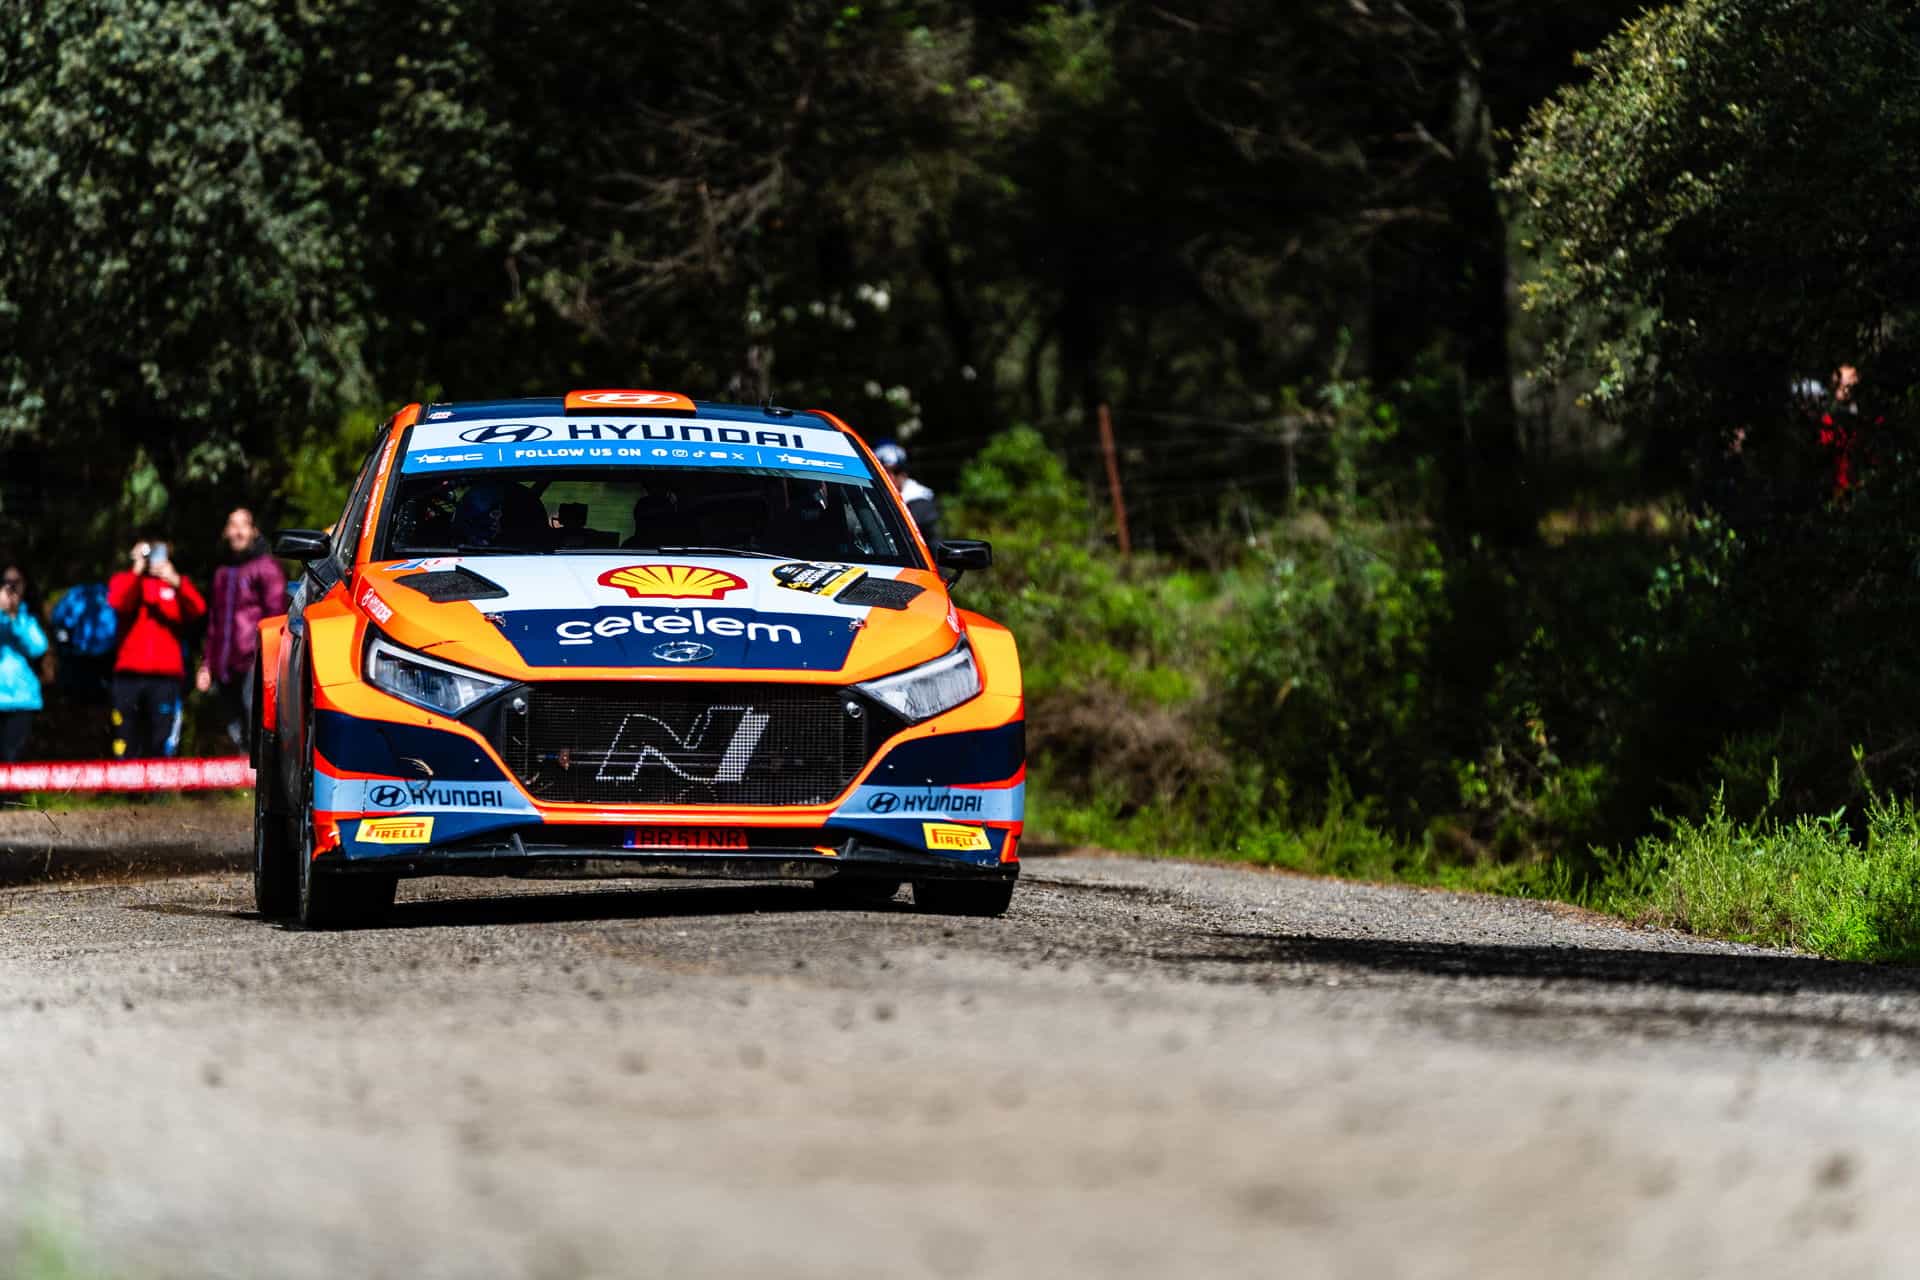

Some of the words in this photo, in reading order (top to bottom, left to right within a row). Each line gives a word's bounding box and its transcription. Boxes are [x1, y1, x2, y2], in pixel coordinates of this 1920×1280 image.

[568, 424, 805, 450] HYUNDAI
[515, 448, 585, 460] FOLLOW
[589, 448, 613, 458] US
[617, 448, 642, 458] ON
[556, 609, 803, 646] cetelem
[409, 785, 503, 808] HYUNDAI
[903, 793, 982, 812] HYUNDAI
[366, 823, 425, 838] PIRELLI
[931, 829, 982, 846] PIRELLI
